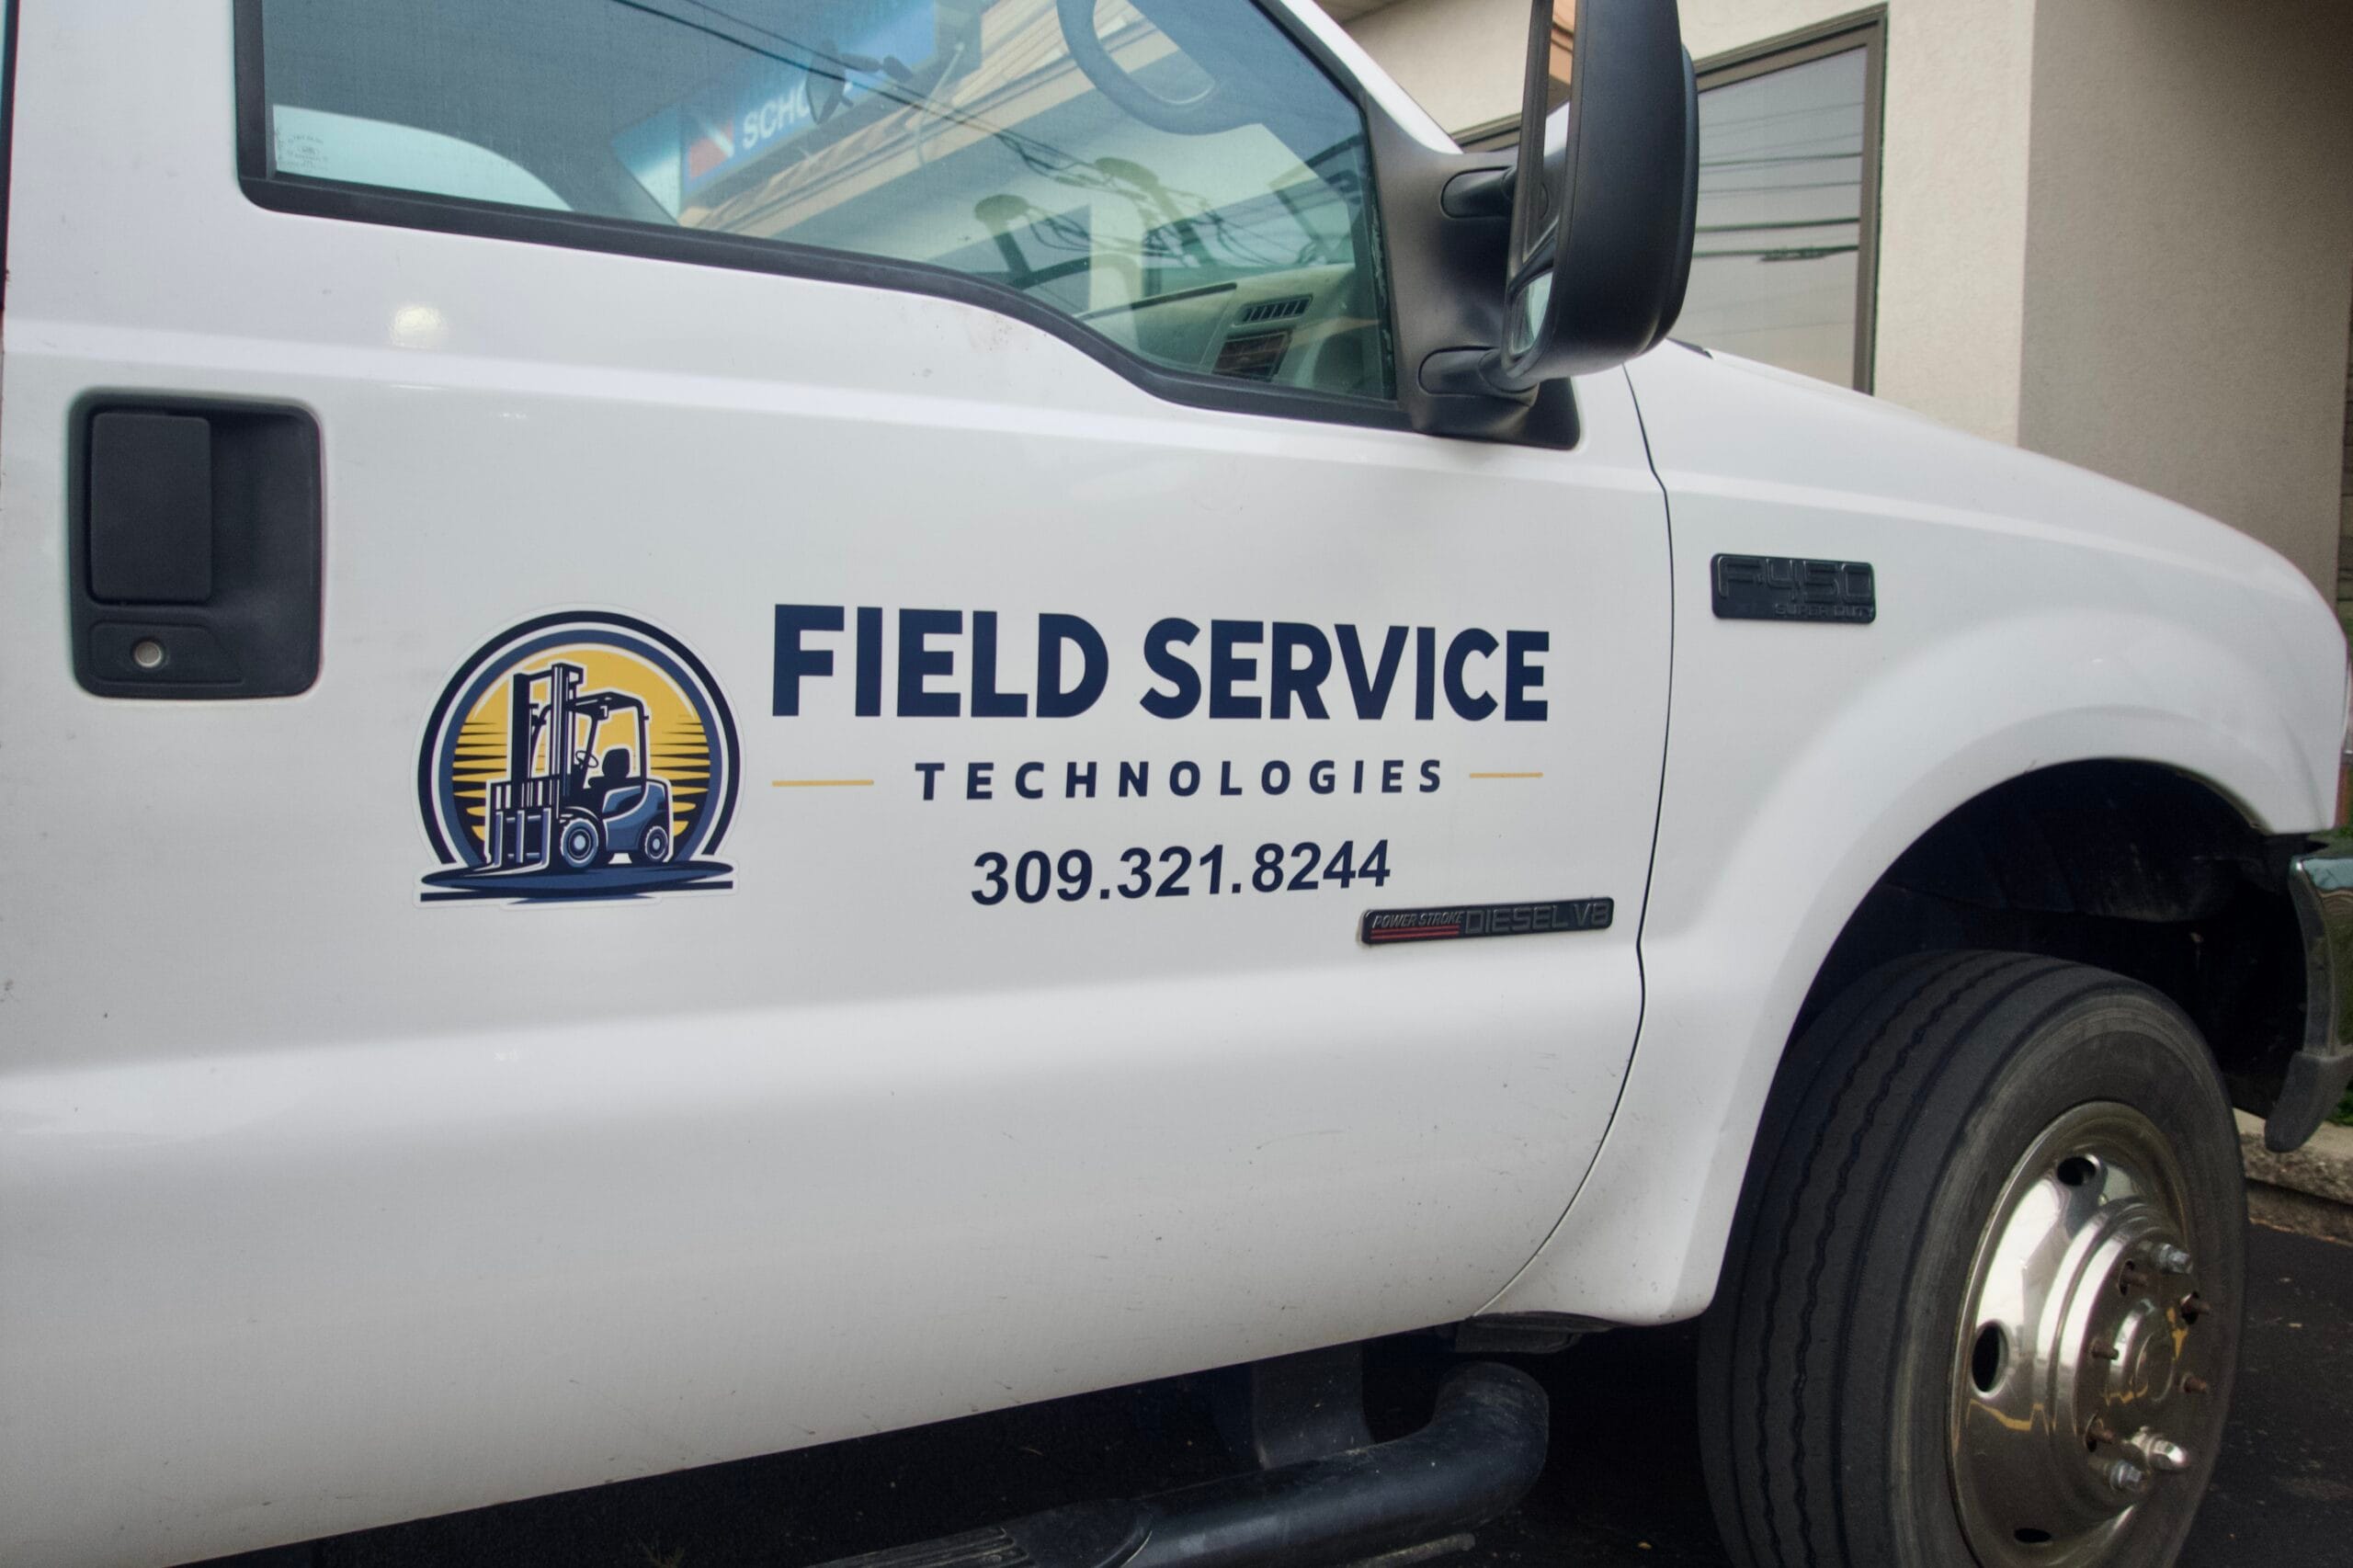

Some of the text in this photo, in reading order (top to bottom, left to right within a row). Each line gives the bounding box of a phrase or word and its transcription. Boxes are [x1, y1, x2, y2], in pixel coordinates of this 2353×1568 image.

[1774, 603, 1874, 619] SUPER DUTY
[772, 603, 1550, 722] FIELD SERVICE
[915, 759, 1440, 801] TECHNOLOGIES
[971, 838, 1391, 906] 309.321.8244
[1371, 902, 1610, 935] POWER STROKE DIESEL V8
